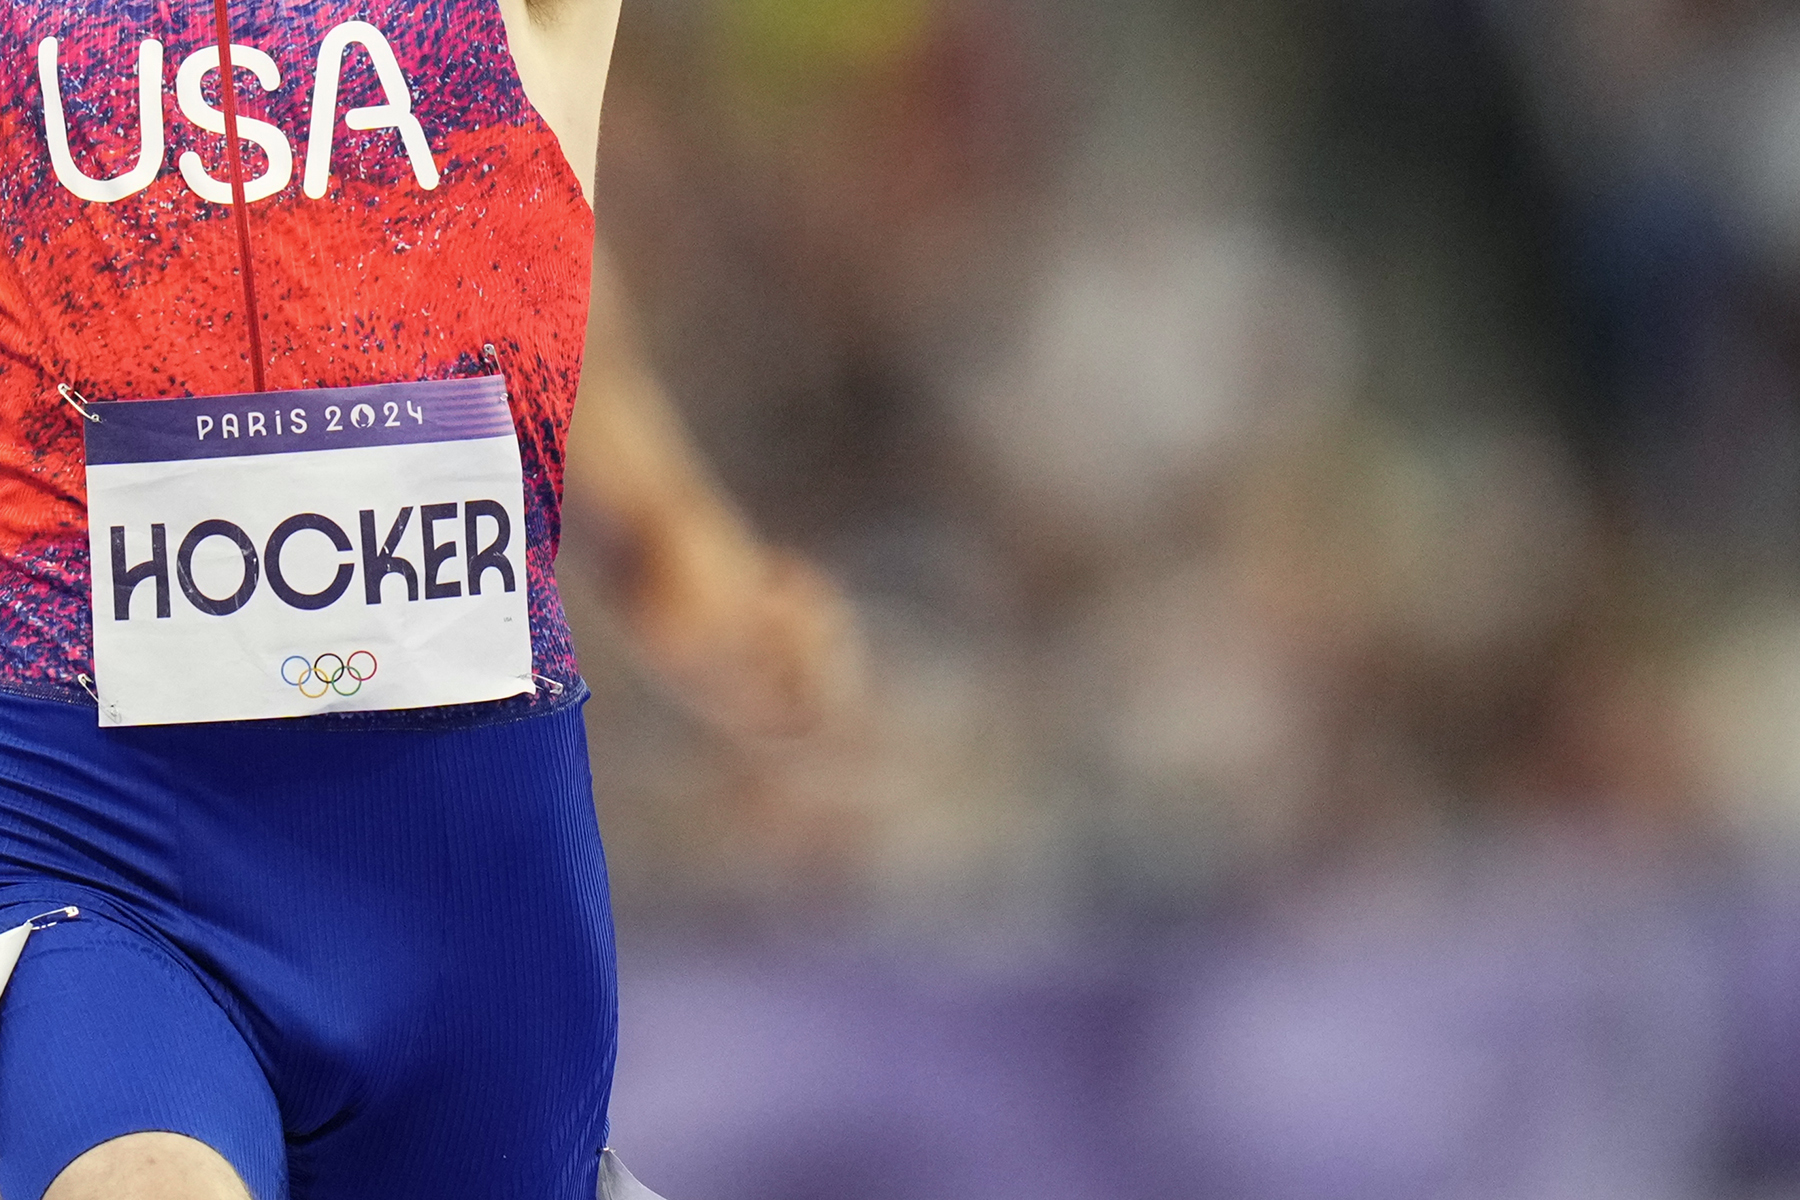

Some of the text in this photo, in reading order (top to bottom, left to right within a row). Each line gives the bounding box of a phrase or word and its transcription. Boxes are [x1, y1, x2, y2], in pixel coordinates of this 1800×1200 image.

[37, 21, 439, 204] USA
[324, 400, 423, 432] 2024
[110, 499, 516, 621] HOCKER
